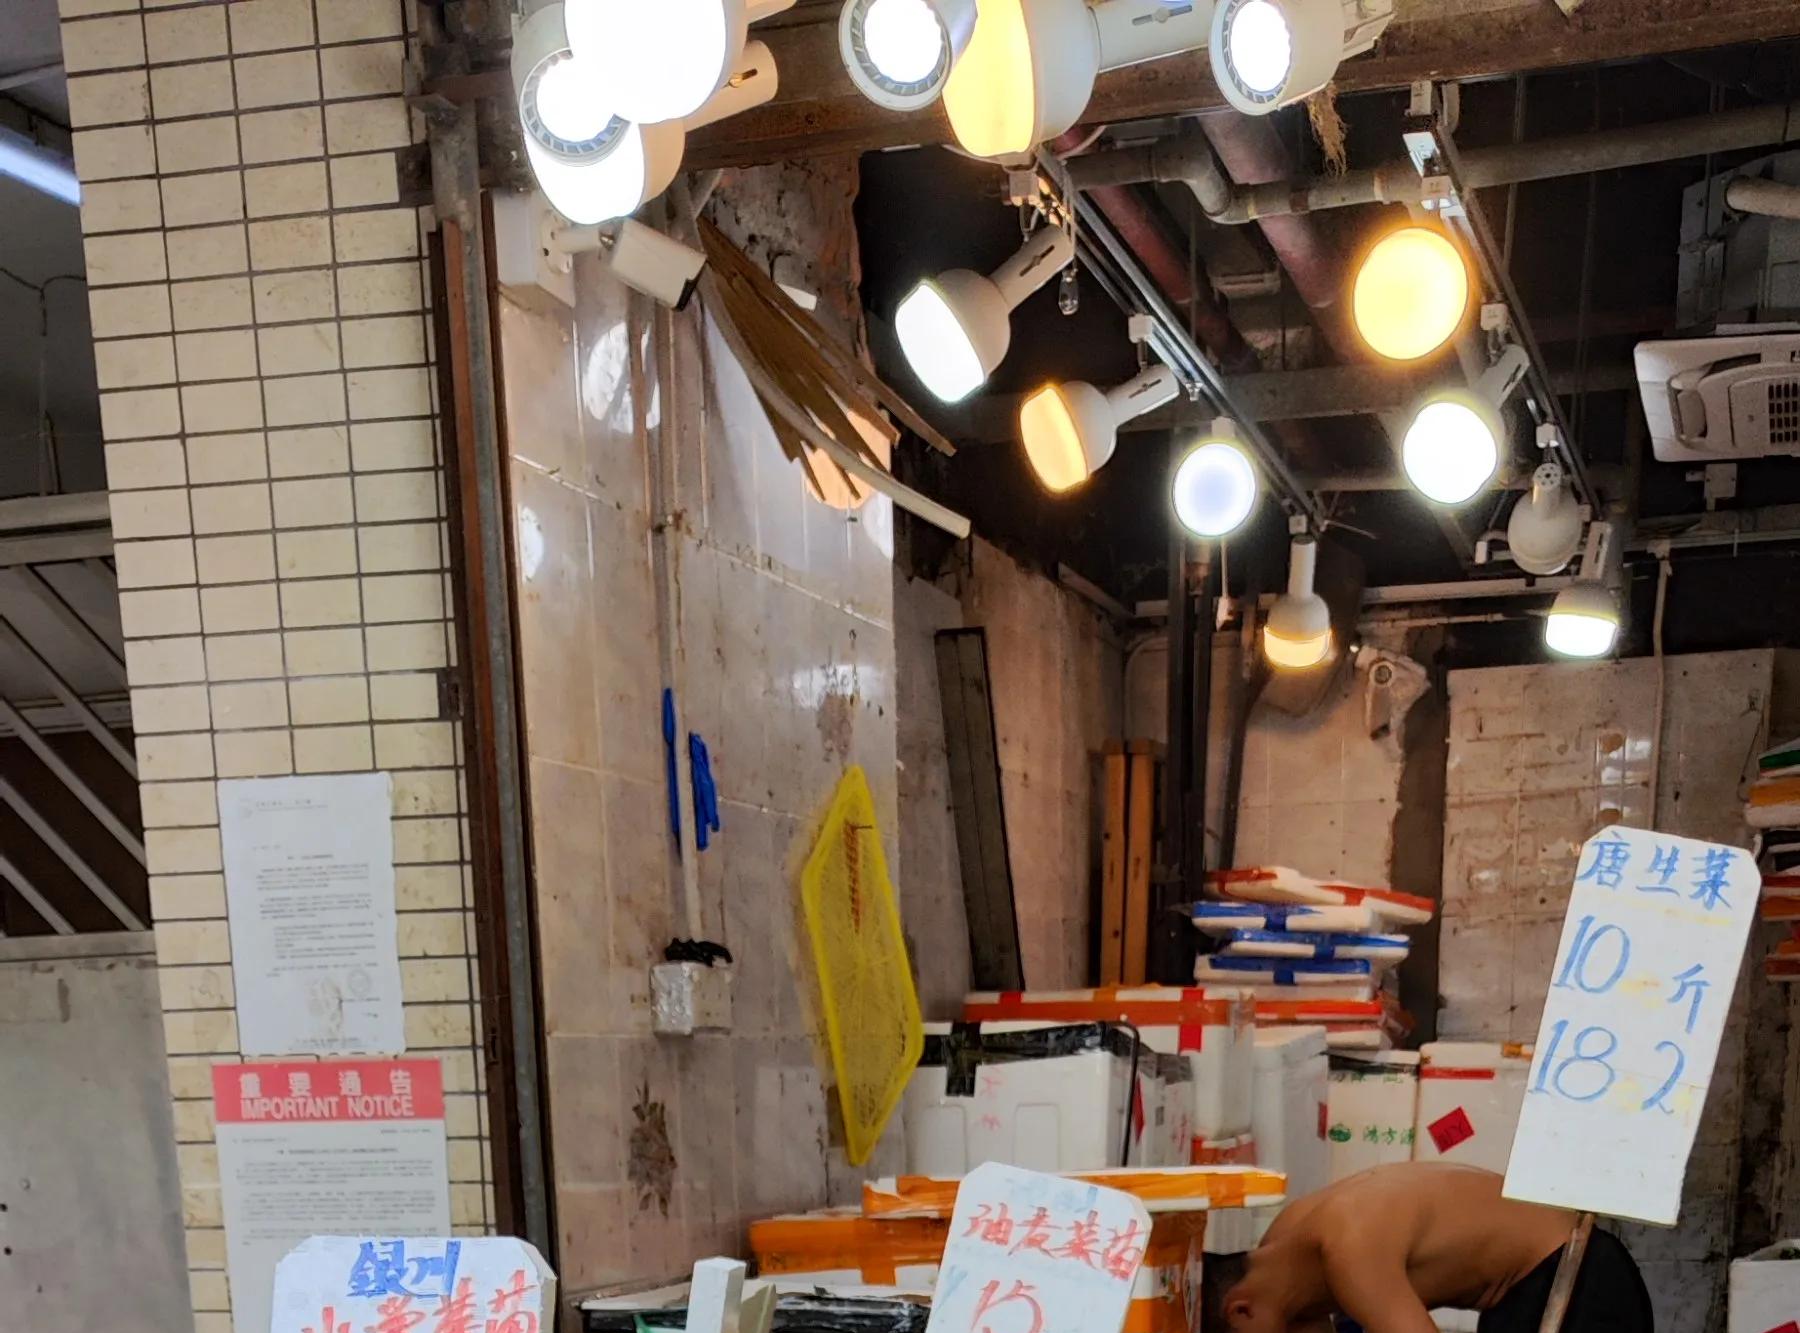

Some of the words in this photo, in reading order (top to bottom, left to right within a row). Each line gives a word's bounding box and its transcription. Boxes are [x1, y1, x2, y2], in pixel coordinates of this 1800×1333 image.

[1576, 830, 1738, 911] 唐生菜
[1552, 915, 1631, 995] 10
[1527, 1019, 1618, 1103] 18
[241, 1097, 338, 1119] IMPORTANT
[347, 1096, 414, 1117] NOTICE
